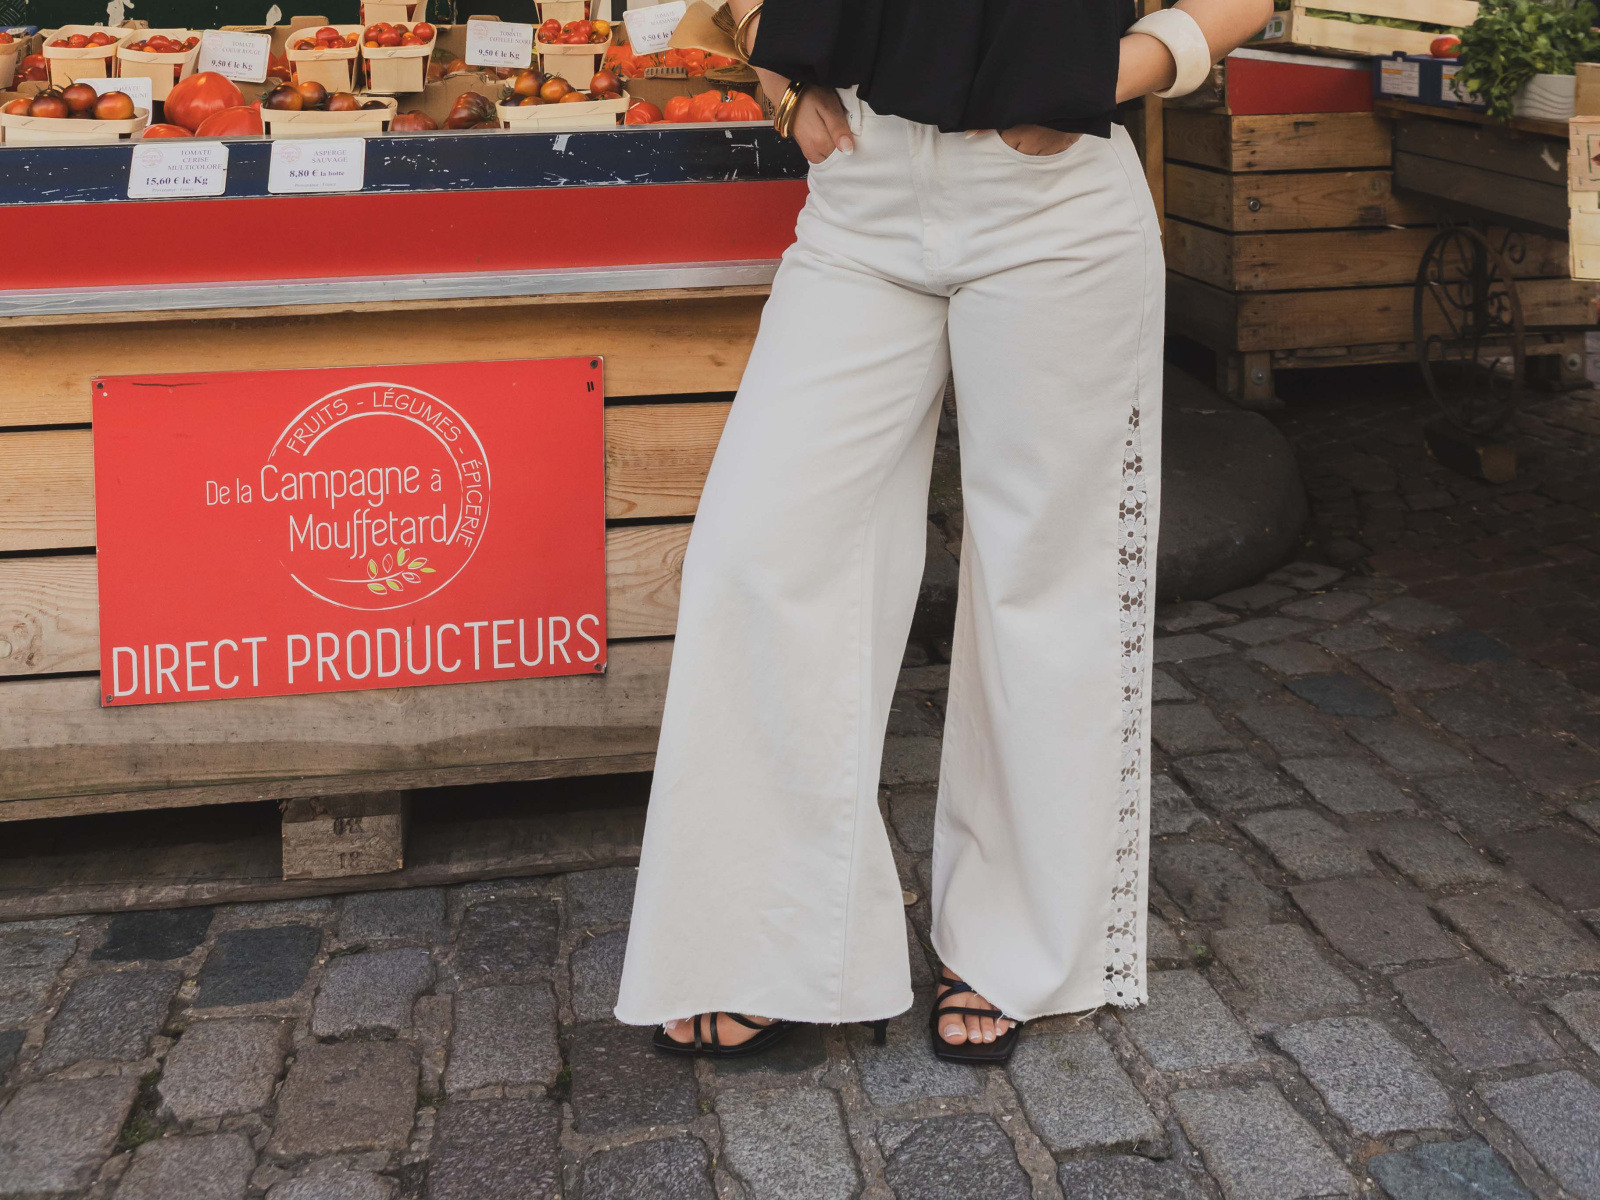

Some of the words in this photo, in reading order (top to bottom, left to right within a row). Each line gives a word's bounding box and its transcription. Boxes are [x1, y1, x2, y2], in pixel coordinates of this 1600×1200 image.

[509, 51, 520, 59] Kg
[242, 62, 253, 71] Kg
[314, 149, 348, 157] ASPERGE
[168, 163, 223, 171] MULTICOLORE
[289, 170, 309, 178] 8,80
[312, 169, 319, 177] €
[146, 177, 171, 186] 15,60
[173, 177, 180, 185] €
[182, 177, 191, 185] le
[194, 176, 208, 185] Kg
[286, 398, 348, 453] FRUITS
[373, 388, 461, 442] LÉGUMES
[456, 459, 483, 547] ÉPICERIE
[206, 480, 231, 506] De
[236, 477, 252, 504] la
[260, 464, 420, 510] Campagne
[430, 468, 442, 492] à
[289, 503, 447, 560] Mouffetard
[112, 636, 268, 698] DIRECT
[286, 613, 600, 685] PRODUCTEURS
